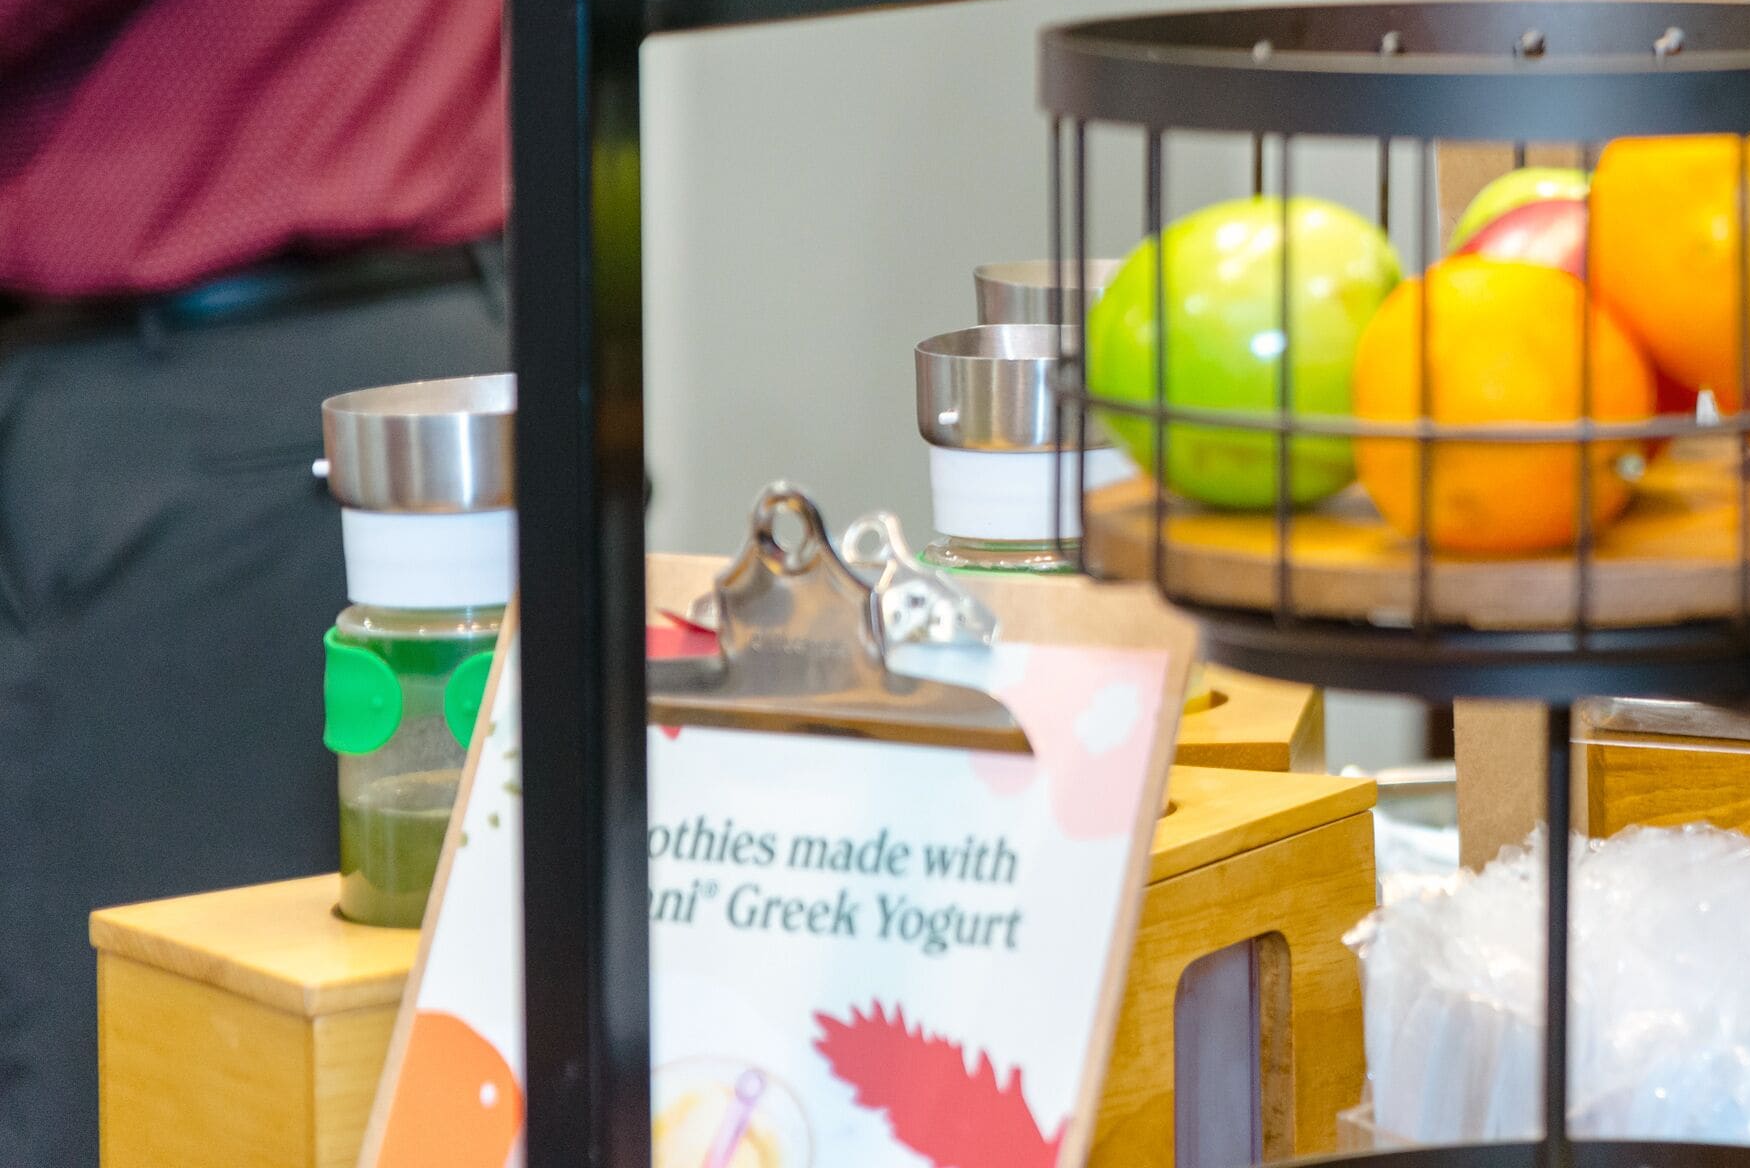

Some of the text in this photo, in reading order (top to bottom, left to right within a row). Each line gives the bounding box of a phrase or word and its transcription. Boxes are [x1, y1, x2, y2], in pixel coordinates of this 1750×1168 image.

[786, 827, 911, 877] made
[922, 835, 1018, 884] with
[649, 878, 1023, 956] ni® Greek Yogurt
